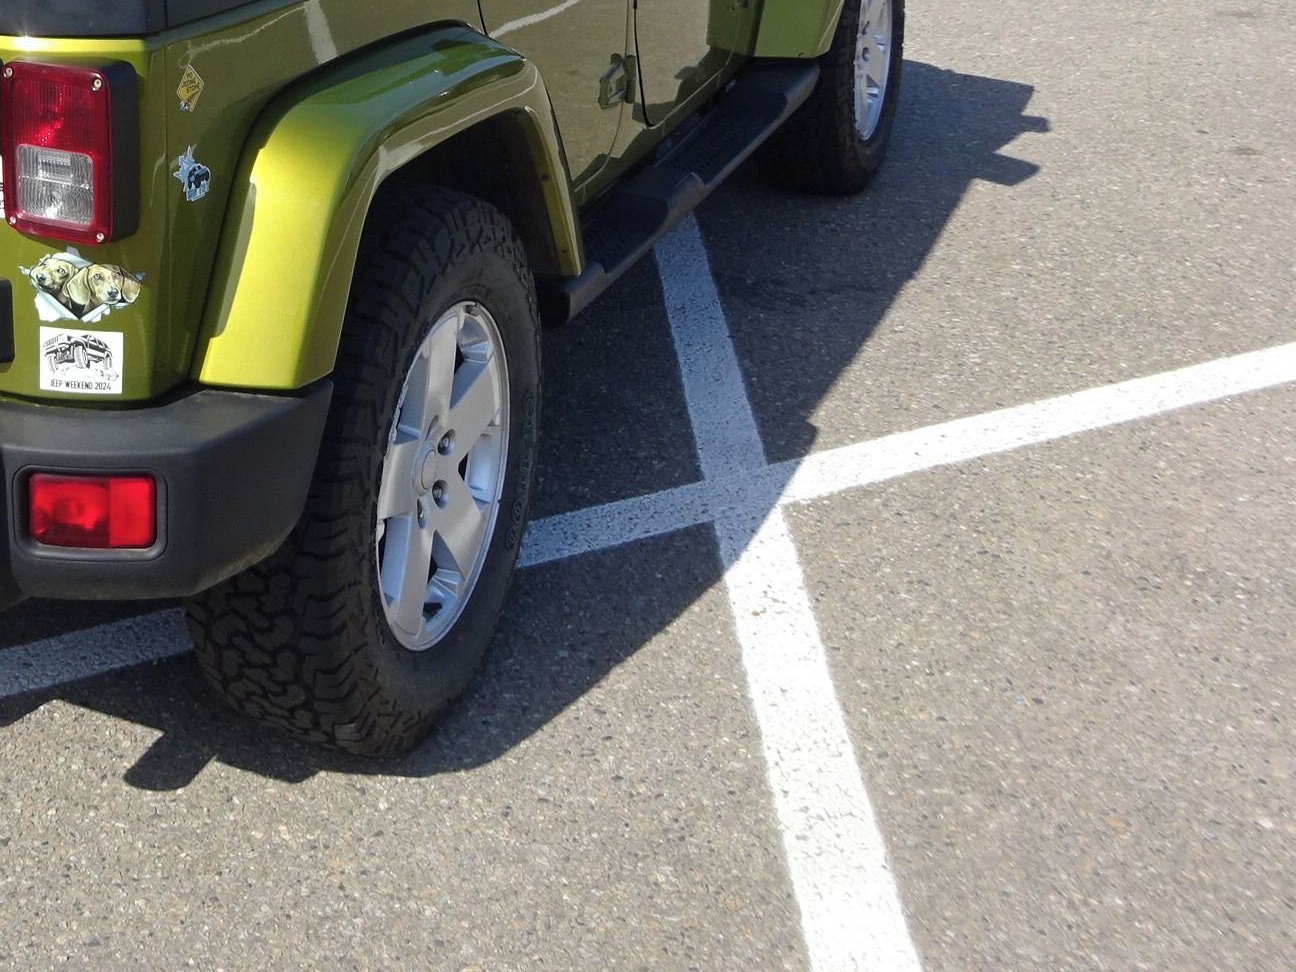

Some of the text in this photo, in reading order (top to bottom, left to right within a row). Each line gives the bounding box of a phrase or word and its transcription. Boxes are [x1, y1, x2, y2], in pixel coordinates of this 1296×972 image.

[50, 379, 112, 391] JEEP WEEKEND 2024
